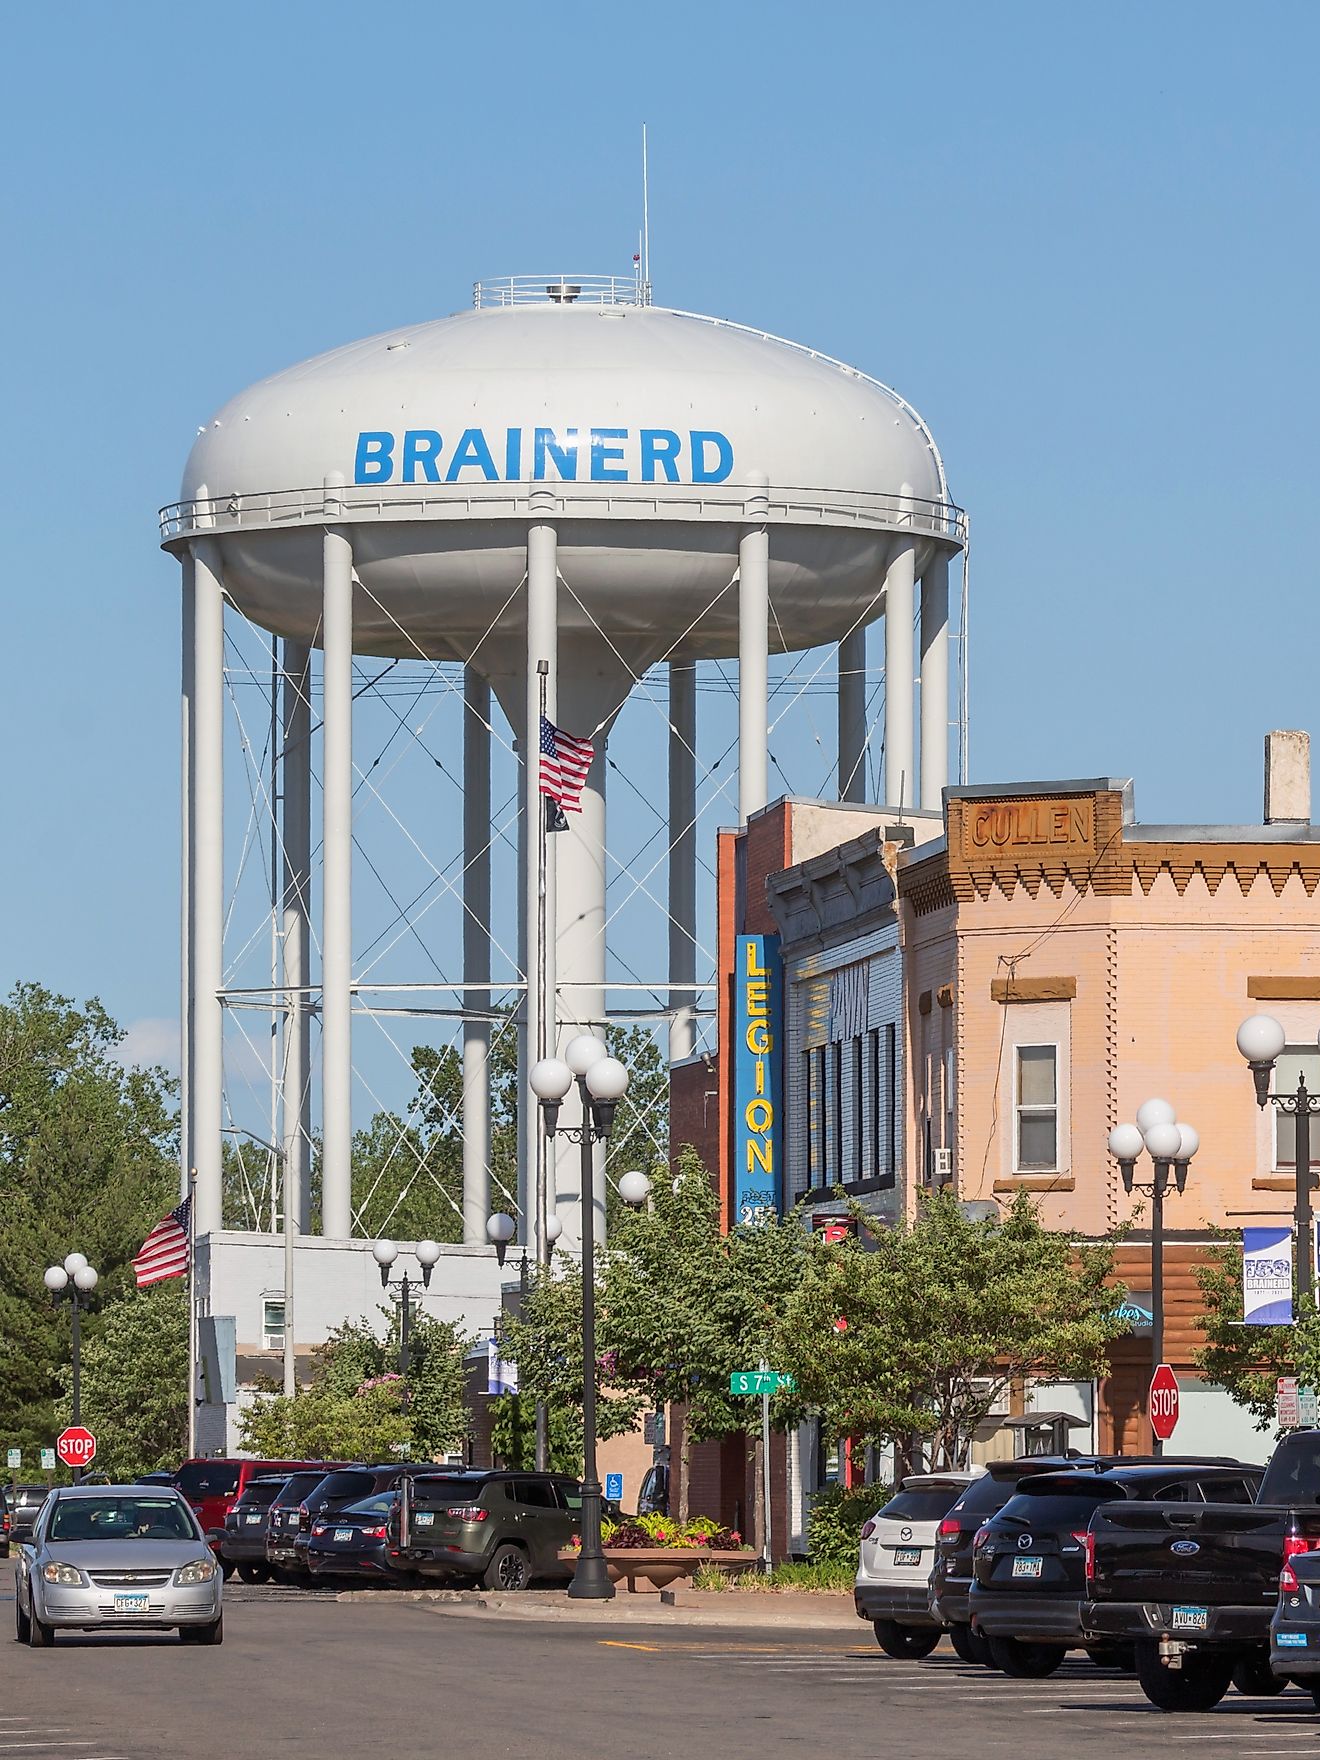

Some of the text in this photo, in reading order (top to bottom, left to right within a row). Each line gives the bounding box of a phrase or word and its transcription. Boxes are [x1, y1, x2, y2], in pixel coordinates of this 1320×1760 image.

[354, 427, 734, 484] BRAINERD
[970, 804, 1091, 846] CULLEN
[745, 942, 773, 1174] LEGION
[1247, 1279, 1289, 1289] BRAINERD
[740, 1375, 748, 1391] S
[753, 1372, 771, 1391] 7th
[1152, 1388, 1178, 1417] STOP
[60, 1438, 93, 1455] STOP
[1175, 1543, 1194, 1552] Ford
[1174, 1611, 1206, 1625] AVU 826
